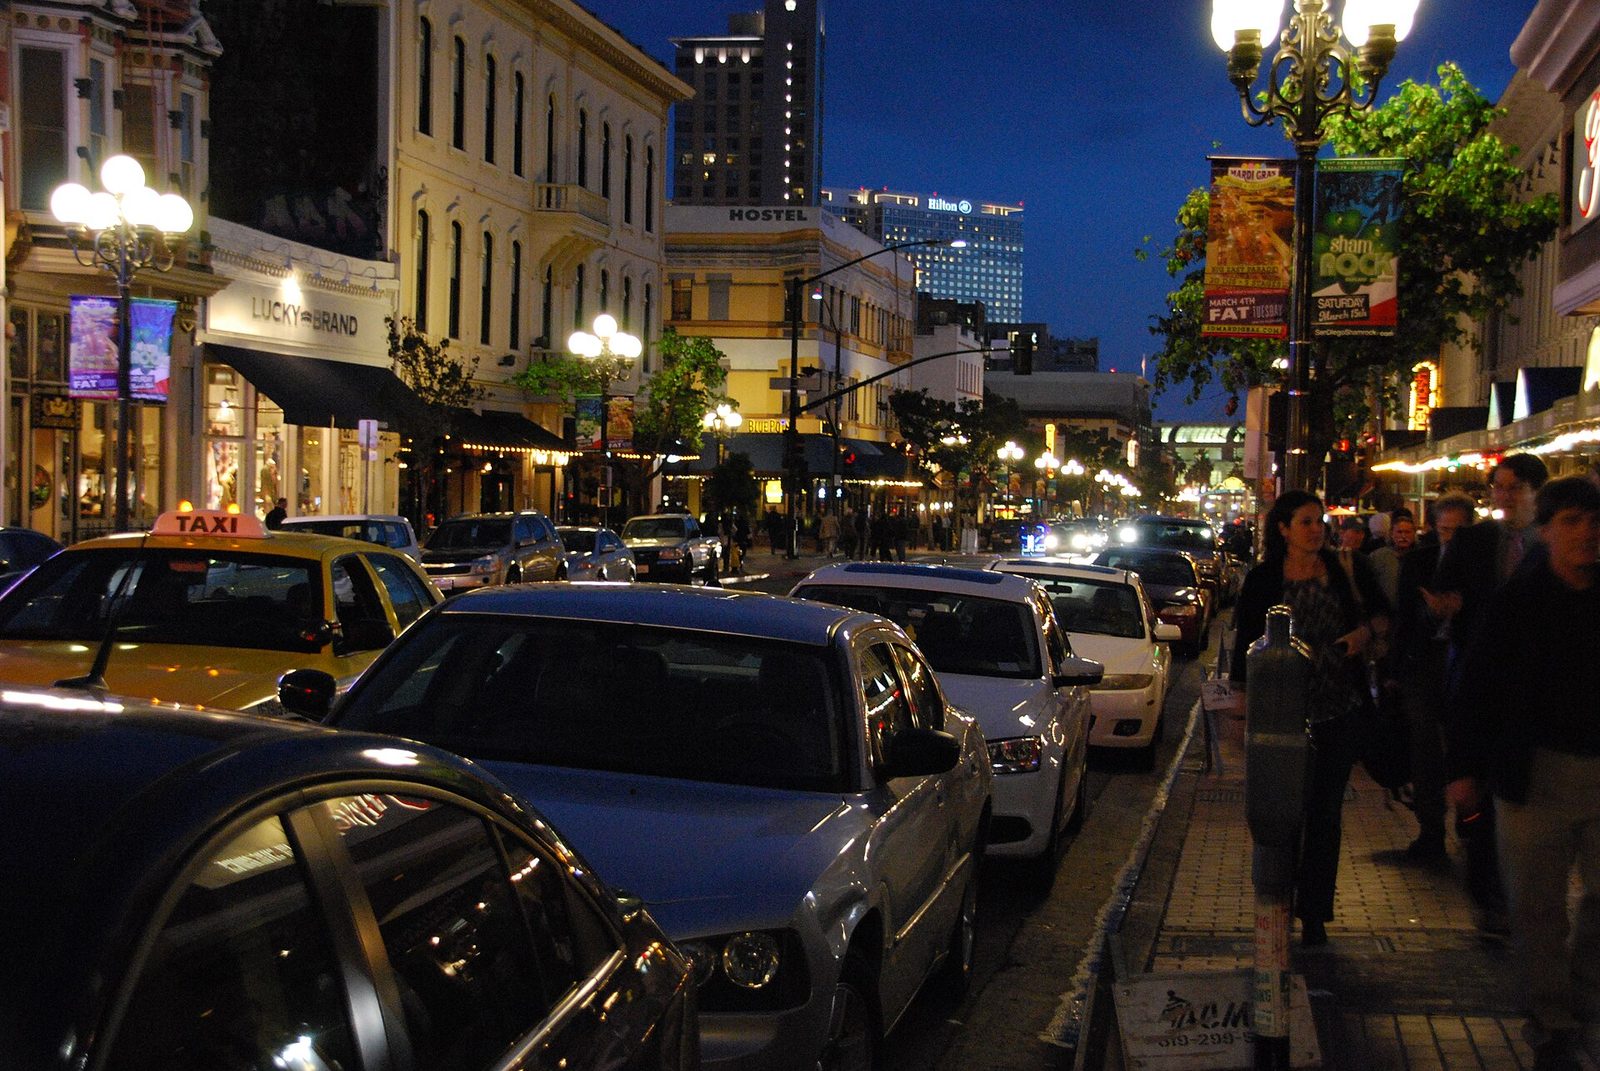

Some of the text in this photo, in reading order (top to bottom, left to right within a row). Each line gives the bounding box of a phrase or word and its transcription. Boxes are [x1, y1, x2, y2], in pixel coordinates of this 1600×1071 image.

[1230, 169, 1277, 180] MARDI GRAS
[928, 198, 957, 212] Hilton
[730, 209, 808, 222] HOSTEL
[1330, 235, 1374, 254] sham
[1320, 252, 1395, 277] ROCK
[1209, 297, 1256, 307] MARCH 4TH
[1317, 298, 1365, 309] SATURDAY
[252, 297, 358, 336] LUCKY BRAND
[1209, 304, 1284, 322] FAT TUESDAY
[73, 380, 98, 389] FAT
[176, 515, 238, 533] TAXI
